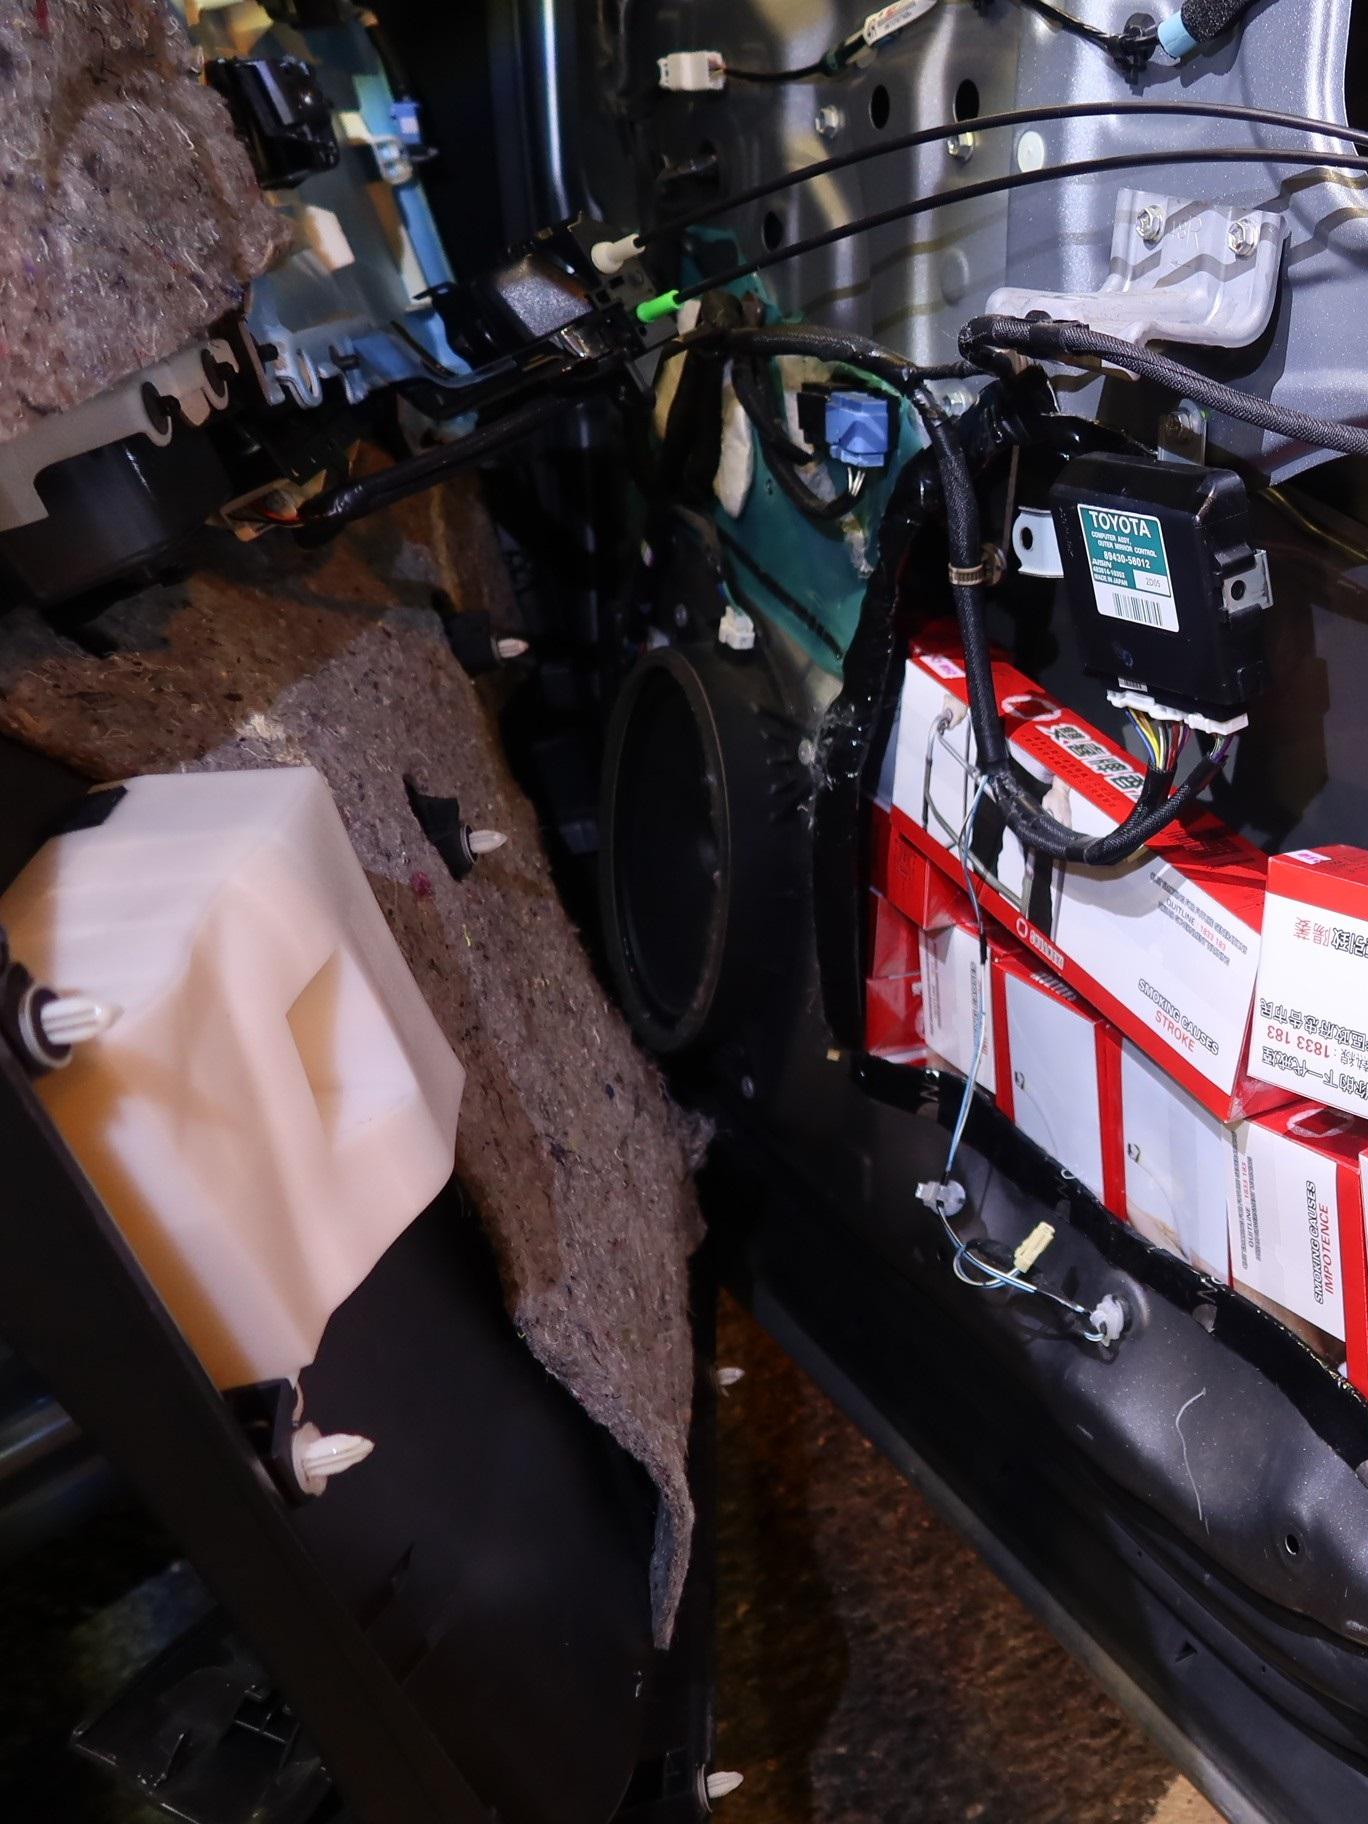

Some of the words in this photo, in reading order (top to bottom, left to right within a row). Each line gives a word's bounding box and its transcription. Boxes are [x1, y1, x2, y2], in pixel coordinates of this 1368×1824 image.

[1089, 510, 1152, 538] TOYOTA
[1091, 531, 1116, 541] COMPUTER
[1097, 539, 1114, 549] OUTER
[1115, 543, 1133, 553] MIRROR
[1134, 547, 1158, 558] CONTROL
[1103, 551, 1151, 569] 89430-58012
[1113, 576, 1128, 587] JAPAN
[1138, 978, 1181, 1023] SMOKING
[1180, 1015, 1220, 1056] CAUSES
[1155, 1010, 1196, 1053] STROKE
[1267, 1025, 1291, 1045] 183
[1297, 1035, 1331, 1059] 1833
[1306, 1180, 1320, 1239] CAUSES
[1319, 1203, 1335, 1296] IMPOTENCE
[1310, 1238, 1324, 1305] SMOKING
